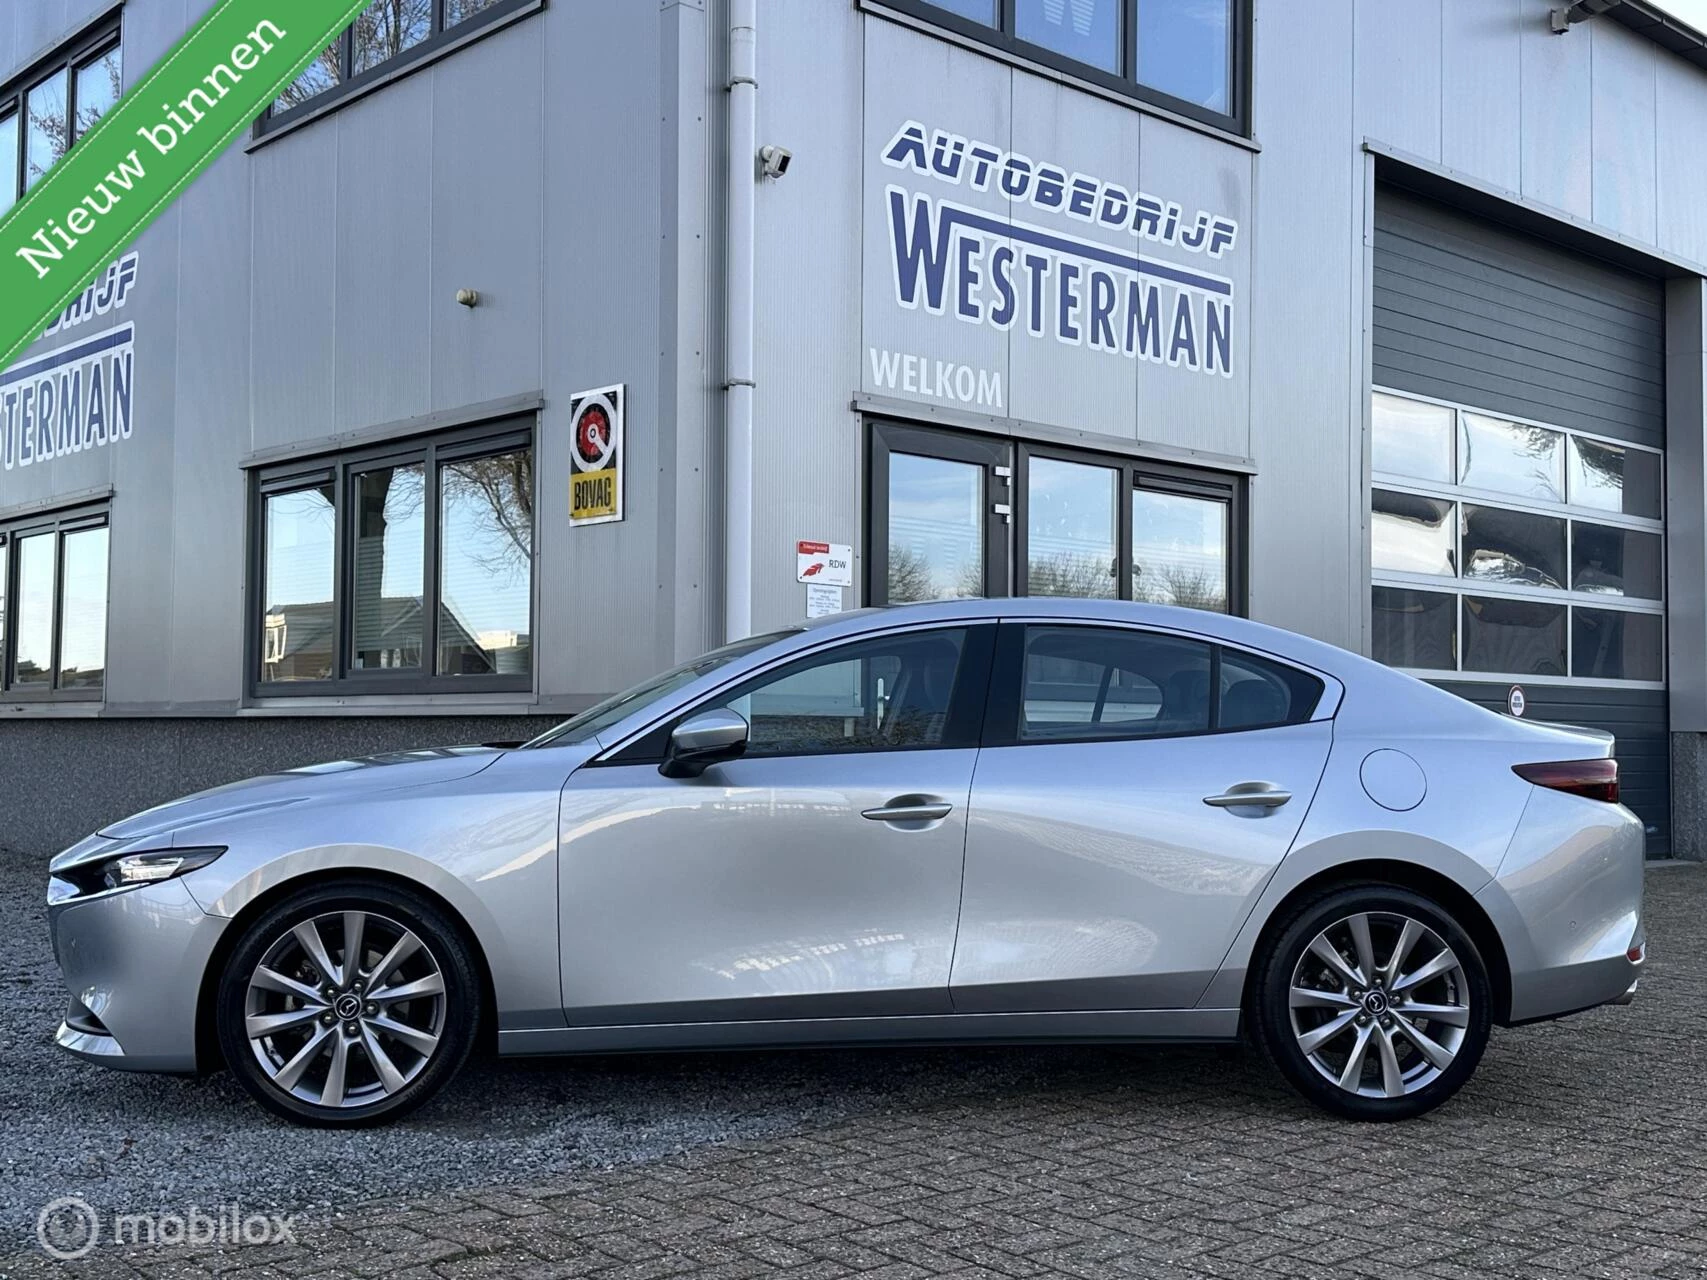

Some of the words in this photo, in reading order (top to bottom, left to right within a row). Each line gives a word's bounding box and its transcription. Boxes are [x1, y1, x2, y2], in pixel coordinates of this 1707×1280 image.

[888, 190, 1233, 375] WESTERMAN
[0, 351, 133, 466] TERMAN
[869, 347, 1004, 409] WELKOM
[573, 476, 612, 511] BOVAG
[828, 559, 847, 569] RDW
